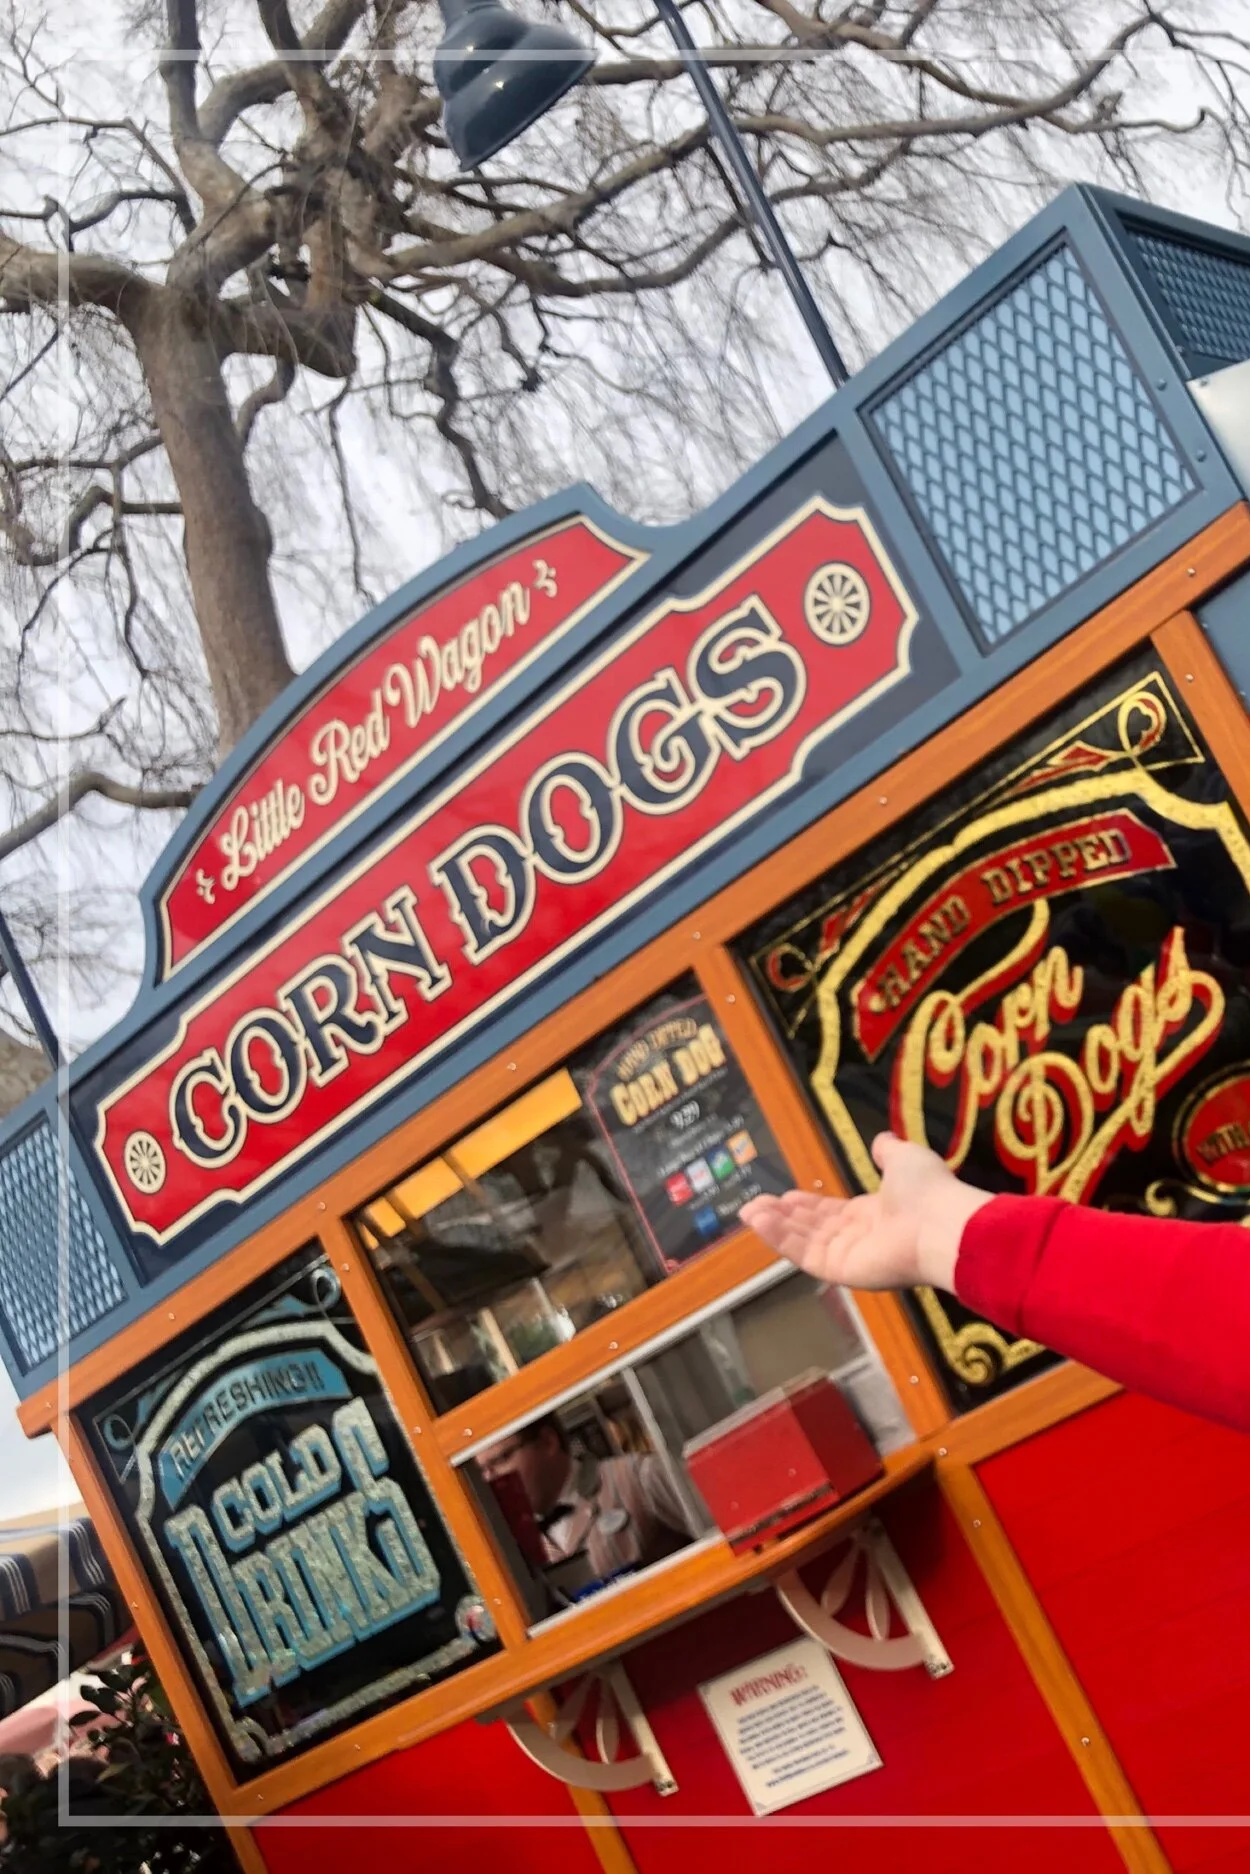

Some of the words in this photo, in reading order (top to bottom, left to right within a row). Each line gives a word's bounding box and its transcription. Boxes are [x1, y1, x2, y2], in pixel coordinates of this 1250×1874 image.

[220, 778, 305, 892] Little
[309, 688, 391, 806] Red
[383, 581, 532, 728] Wagon
[168, 884, 452, 1169] CORN
[429, 592, 806, 967] DOGS
[876, 894, 972, 1008] HAND
[980, 827, 1133, 905] DIPPED
[609, 1059, 679, 1126] CORN
[672, 1023, 727, 1087] DOG
[891, 897, 1084, 1173] Corn
[993, 926, 1226, 1199] Dogs
[163, 1397, 441, 1709] DRINKS
[210, 1422, 342, 1553] COLD
